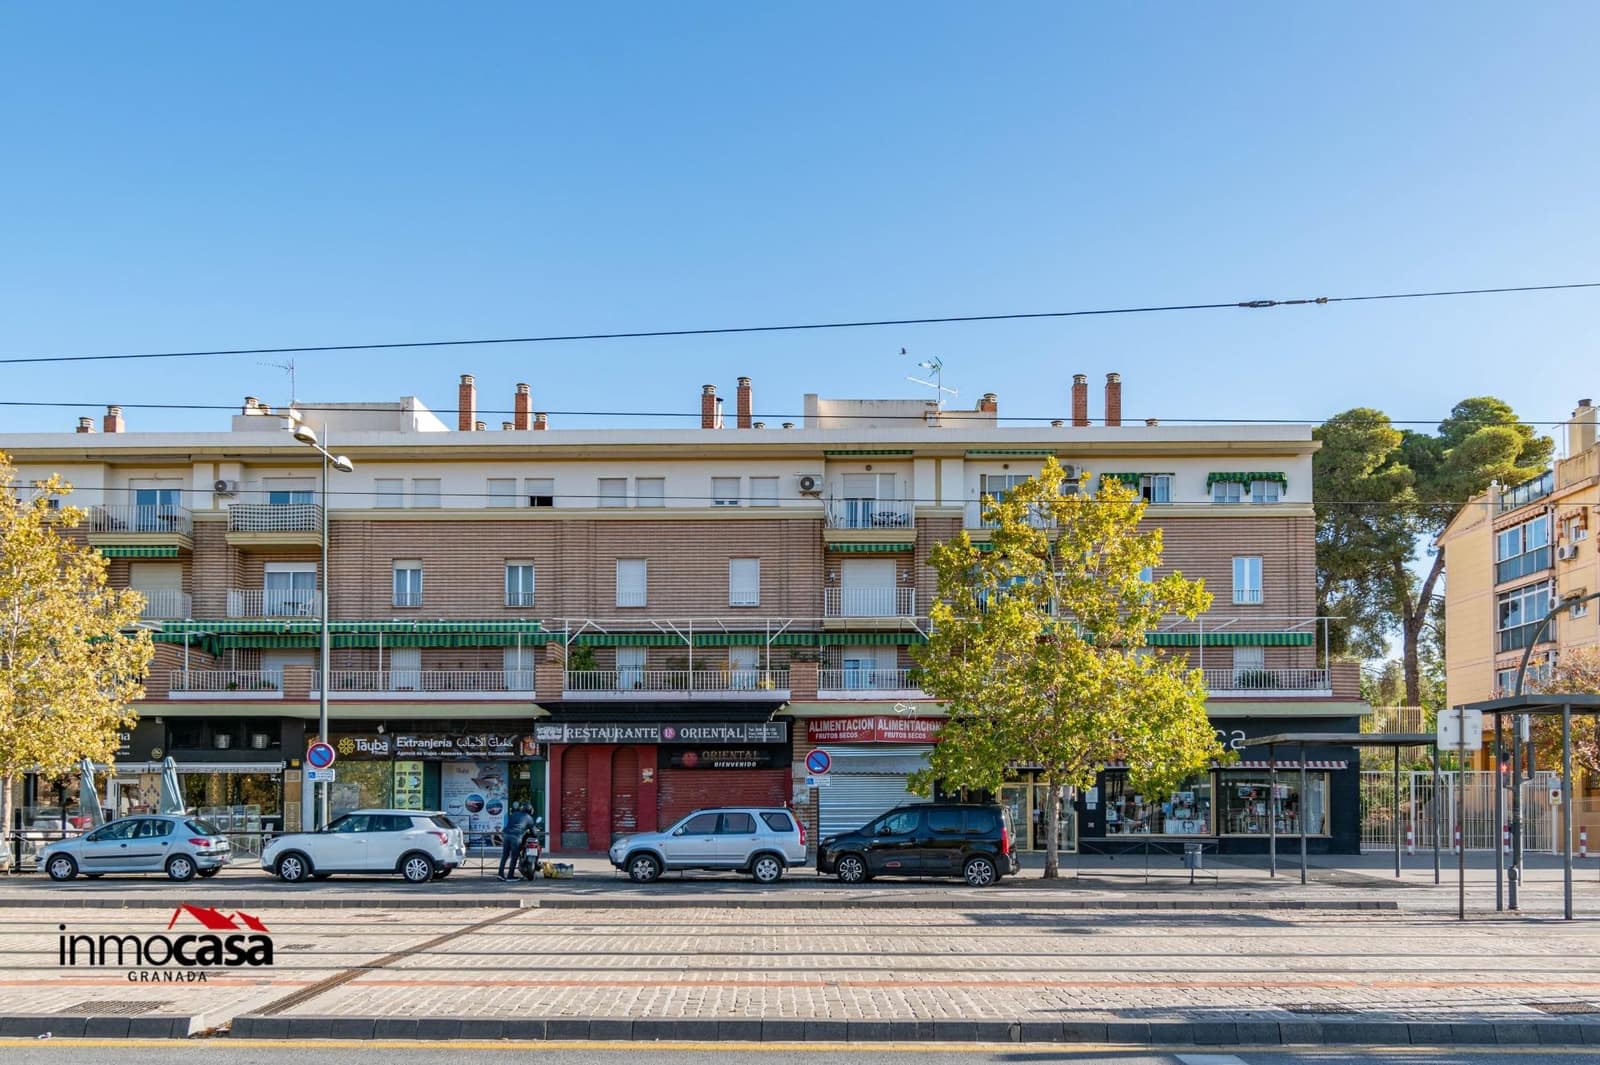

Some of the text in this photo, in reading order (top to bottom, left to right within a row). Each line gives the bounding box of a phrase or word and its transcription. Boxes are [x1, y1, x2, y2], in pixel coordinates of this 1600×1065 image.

[809, 719, 874, 732] ALIMENTACION
[567, 728, 658, 738] RESTAURANTE
[680, 728, 744, 738] ORIENTAL
[354, 738, 388, 754] Tayba
[702, 750, 761, 760] ORIENTAL
